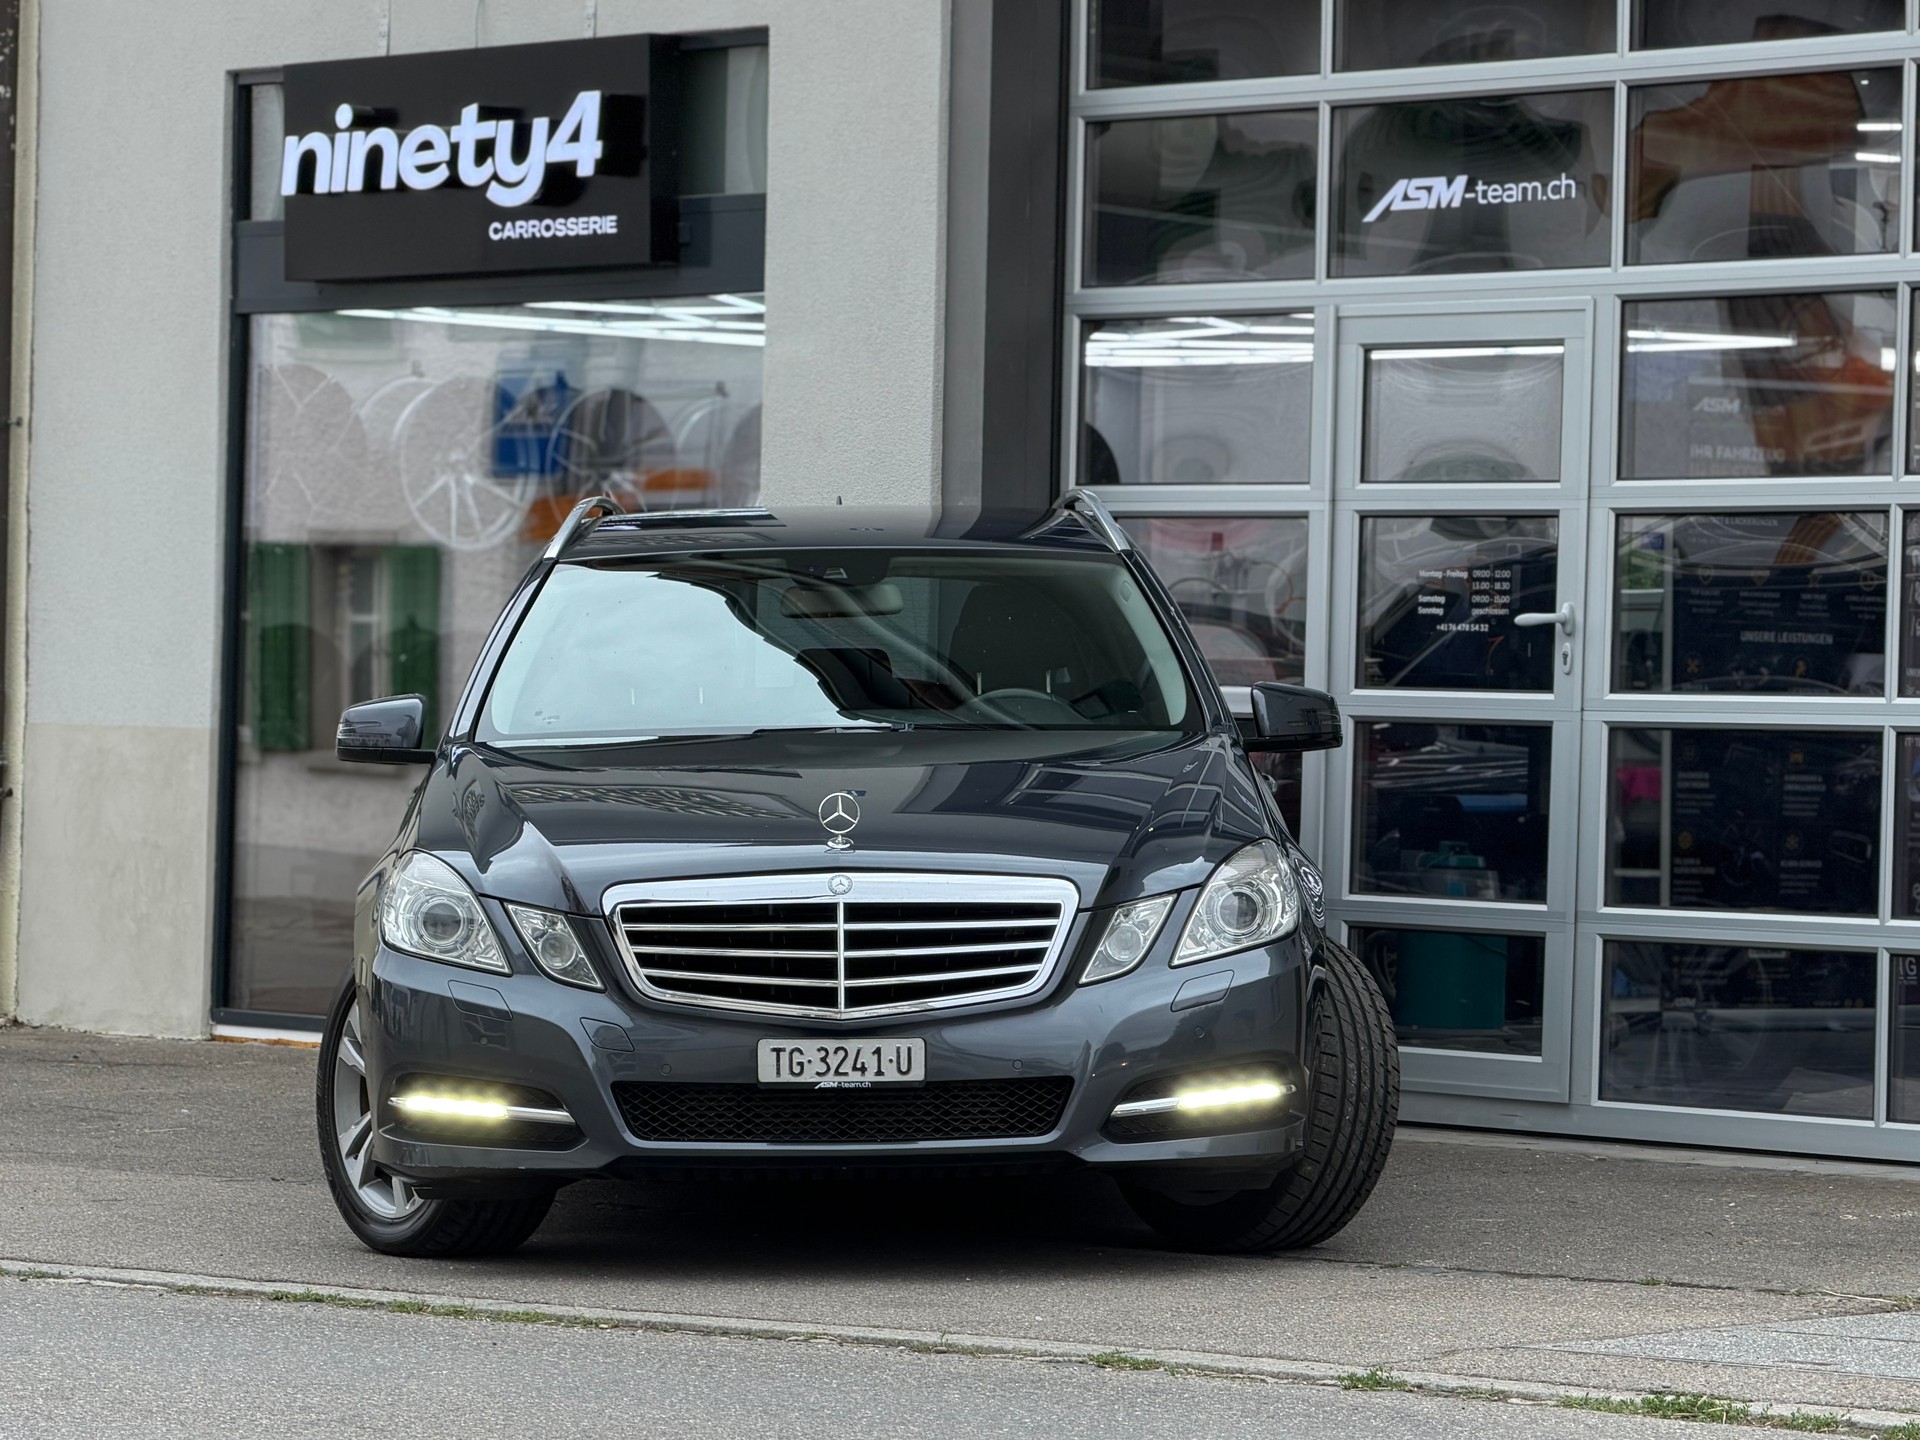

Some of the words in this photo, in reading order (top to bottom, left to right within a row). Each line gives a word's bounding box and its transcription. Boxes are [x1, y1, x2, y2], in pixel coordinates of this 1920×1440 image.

[281, 90, 603, 208] ninety4
[1362, 173, 1576, 223] ASM-team.ch
[488, 215, 618, 240] CARROSSERIE
[1419, 570, 1443, 579] Montag
[1446, 570, 1468, 579] Freitag
[1418, 595, 1446, 604] Samstag
[1418, 606, 1444, 616] Sonntag
[1471, 607, 1509, 616] geschlossen
[814, 1081, 872, 1089] ASM-team.ch
